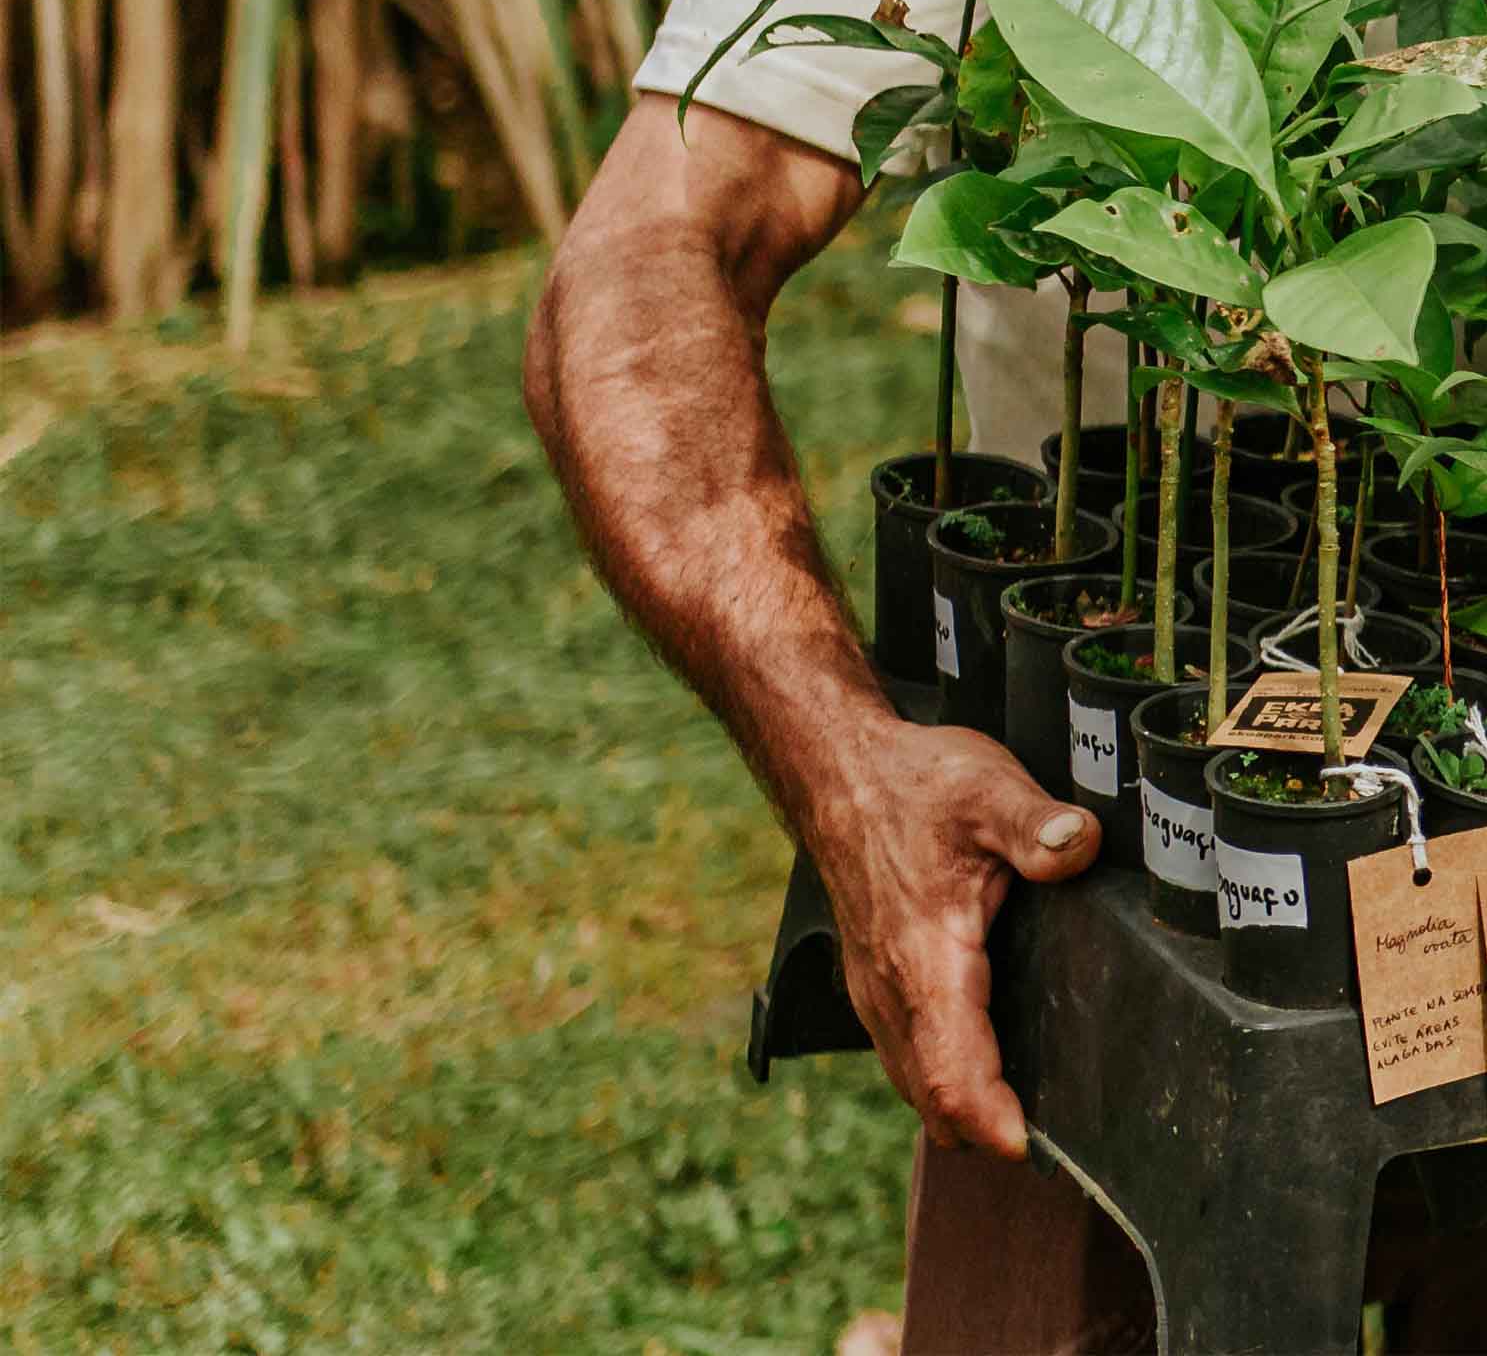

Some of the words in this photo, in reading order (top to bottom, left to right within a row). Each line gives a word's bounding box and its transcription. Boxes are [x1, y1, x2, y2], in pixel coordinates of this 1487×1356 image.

[1377, 916, 1456, 955] Magnolia
[1373, 1006, 1417, 1030] PLANTE
[1426, 996, 1445, 1011] NA
